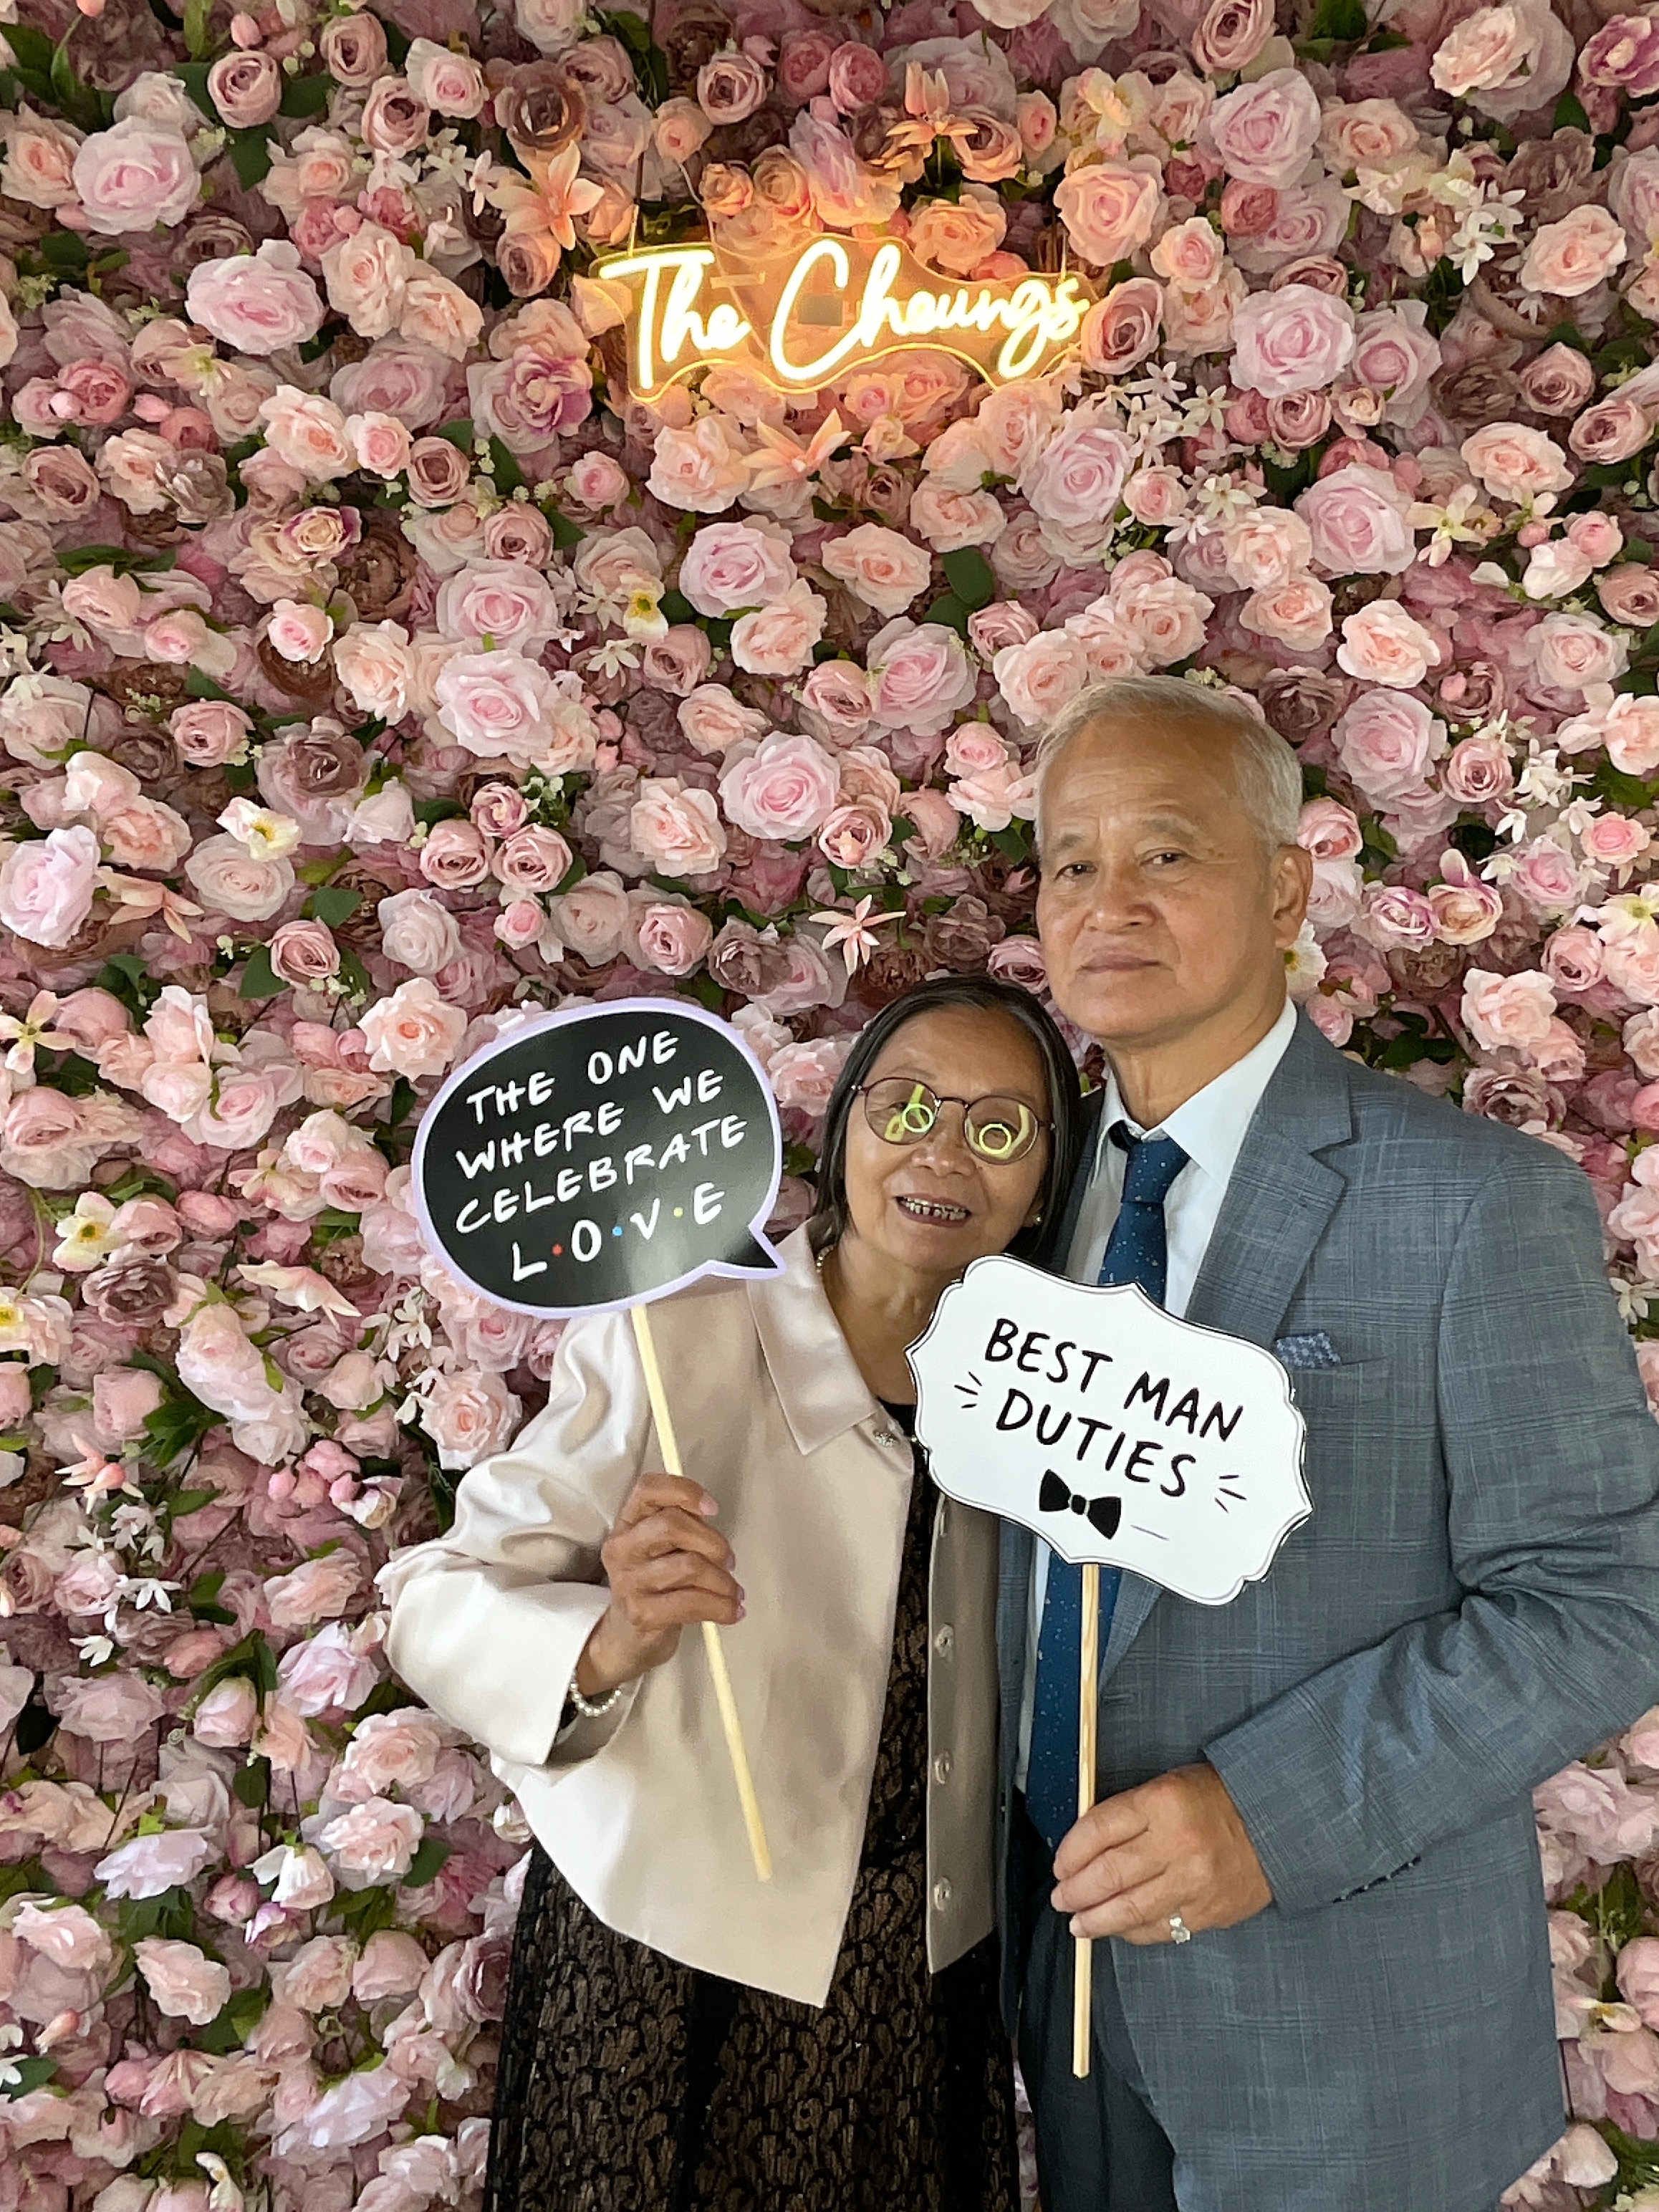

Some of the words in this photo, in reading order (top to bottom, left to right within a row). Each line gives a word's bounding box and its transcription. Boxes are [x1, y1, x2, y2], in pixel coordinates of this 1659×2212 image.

[599, 249, 749, 390] The
[769, 239, 1090, 380] Cheungs
[456, 1101, 625, 1180] WHERE
[652, 1069, 723, 1114] WE
[466, 1072, 555, 1124] THE
[587, 1030, 679, 1085] ONE
[456, 1115, 748, 1234] CELEBRATE
[984, 1317, 1113, 1393] BEST
[1123, 1371, 1244, 1442] MAN
[995, 1388, 1196, 1498] DUTIES
